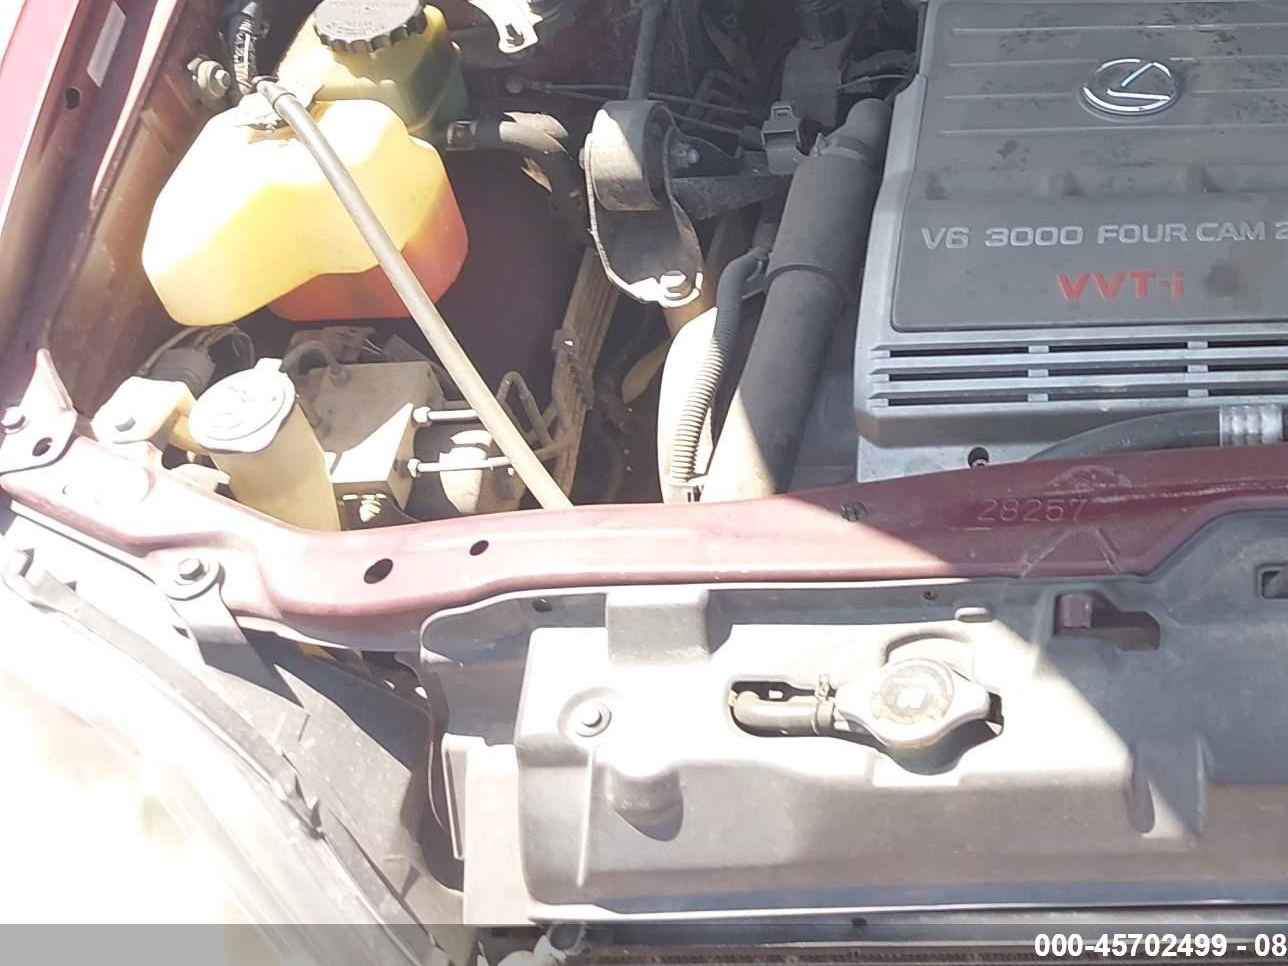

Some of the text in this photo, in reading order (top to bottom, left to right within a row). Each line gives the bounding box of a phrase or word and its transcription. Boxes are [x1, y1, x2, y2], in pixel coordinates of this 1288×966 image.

[921, 227, 969, 250] V6
[984, 226, 1084, 248] 3000
[1097, 222, 1188, 245] FOUR
[1195, 221, 1266, 243] CAM
[1056, 271, 1185, 300] VVT-i
[976, 498, 1089, 522] 28257
